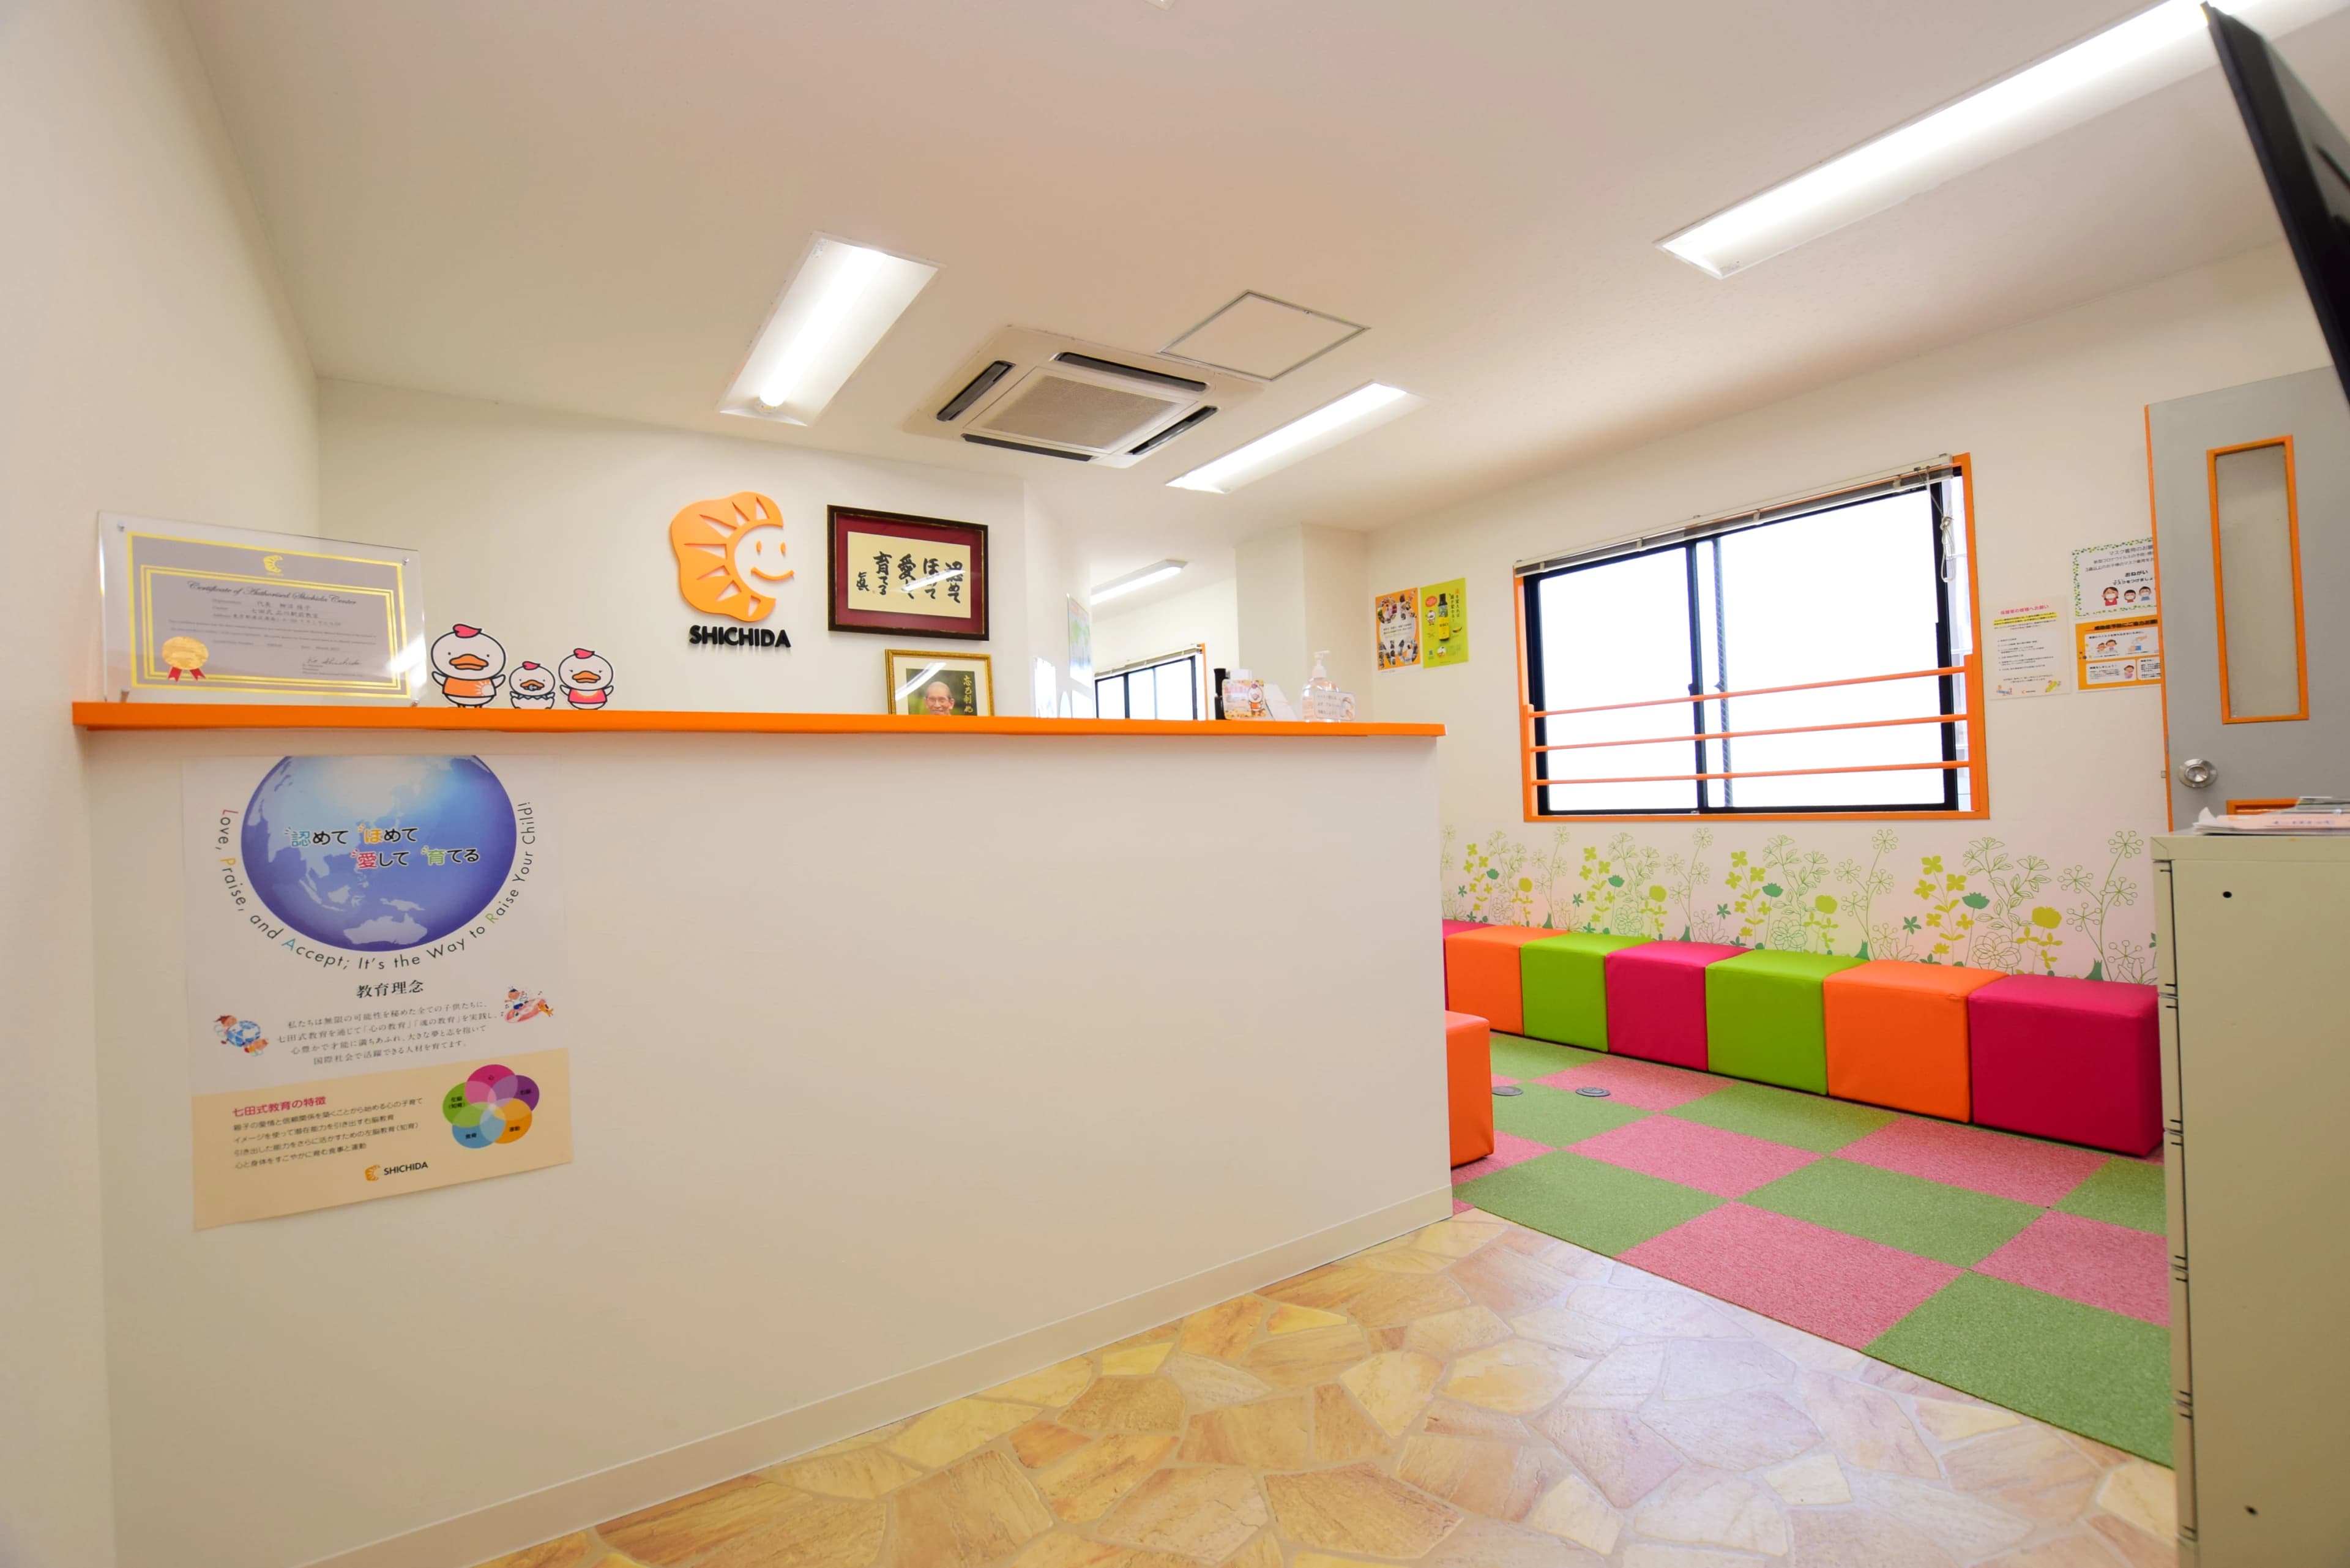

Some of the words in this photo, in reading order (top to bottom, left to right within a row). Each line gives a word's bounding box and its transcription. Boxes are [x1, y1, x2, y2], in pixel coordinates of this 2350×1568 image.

[873, 551, 892, 595] 育てる
[688, 625, 791, 648] SHICHIDA
[215, 808, 239, 850] Love,
[517, 801, 535, 845] Child!
[290, 829, 349, 847] 認めて
[364, 827, 419, 845] ほめて
[357, 850, 410, 868] 愛して
[427, 847, 480, 865] 育てる
[512, 850, 534, 884] Your
[220, 857, 247, 911] Praise,
[485, 889, 520, 924] Raise
[250, 914, 283, 940] and
[469, 924, 485, 939] to
[282, 938, 350, 970] Accept;
[427, 939, 466, 959] Way
[358, 957, 385, 970] It's
[394, 954, 420, 968] the
[356, 979, 425, 999] 教育理念
[233, 1096, 326, 1117] 七田式教育の特徴
[384, 1162, 428, 1175] SHICHIDA
